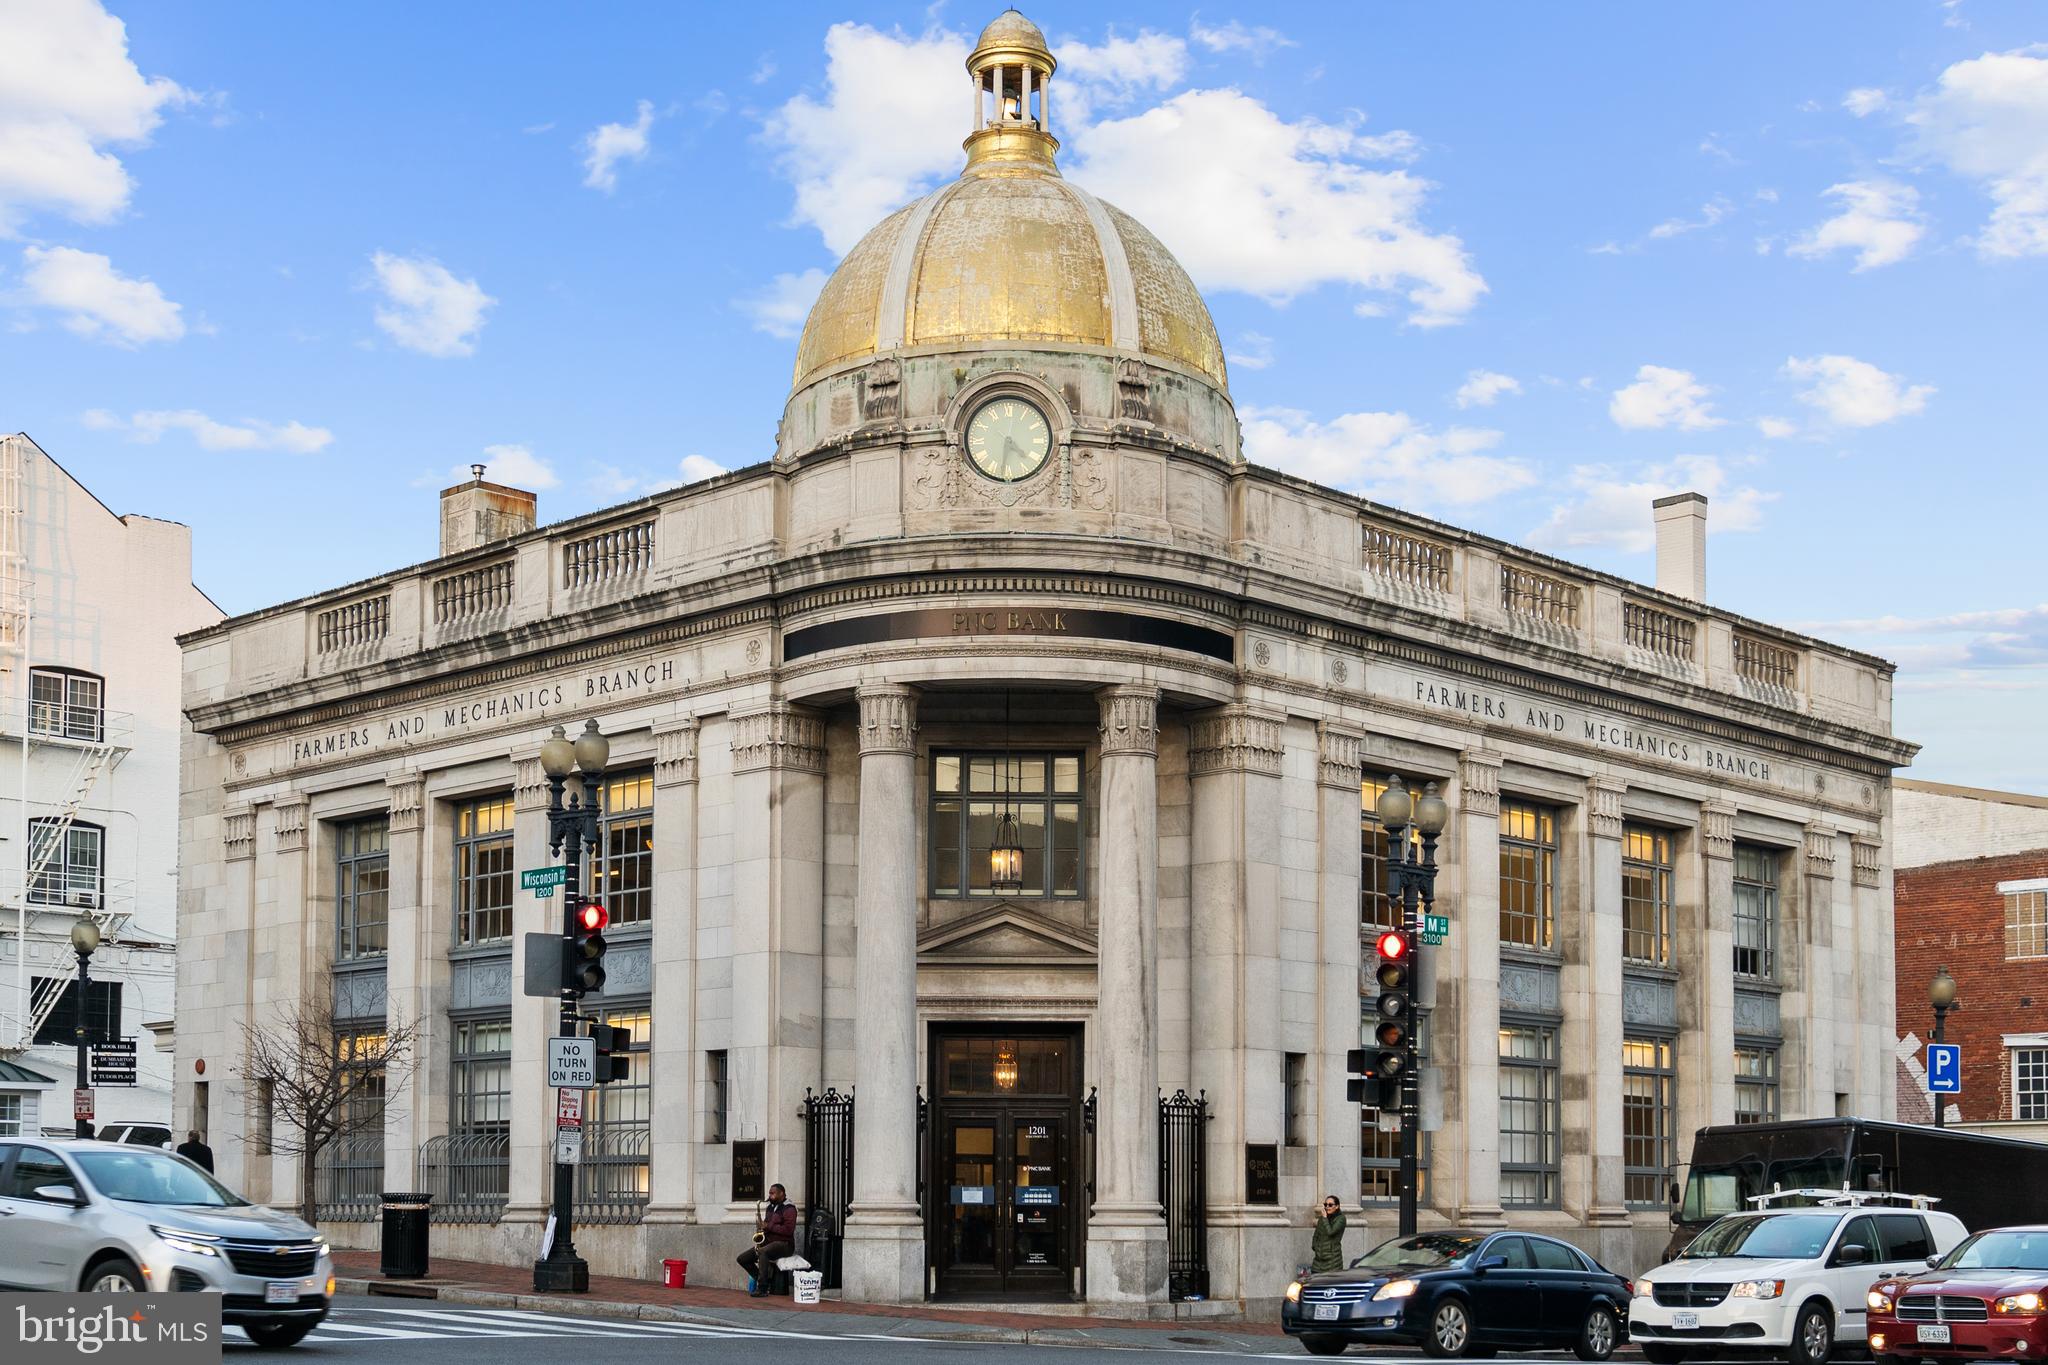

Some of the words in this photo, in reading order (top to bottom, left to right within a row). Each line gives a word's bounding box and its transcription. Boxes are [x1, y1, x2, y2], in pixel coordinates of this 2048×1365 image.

[1006, 612, 1068, 631] BANK
[294, 728, 370, 761] FARMERS
[387, 716, 425, 741] AND
[444, 685, 563, 729] MECHANICS
[585, 660, 674, 698] BRANCH
[1416, 681, 1506, 720] FARMERS
[1526, 707, 1565, 733] AND
[1583, 720, 1689, 762] MECHANICS
[1706, 750, 1770, 781] BRANCH
[524, 869, 558, 886] Wisconsin
[537, 887, 552, 897] 1200
[1428, 917, 1437, 931] M
[1423, 933, 1441, 944] 3100
[563, 1045, 580, 1056] NO
[557, 1057, 587, 1068] TURN
[1936, 1049, 1951, 1075] P
[552, 1071, 566, 1081] ON
[571, 1071, 591, 1082] RED
[1029, 1126, 1046, 1134] 1201
[743, 1157, 758, 1167] PNC
[742, 1167, 760, 1176] BANK
[1257, 1169, 1274, 1178] BANK
